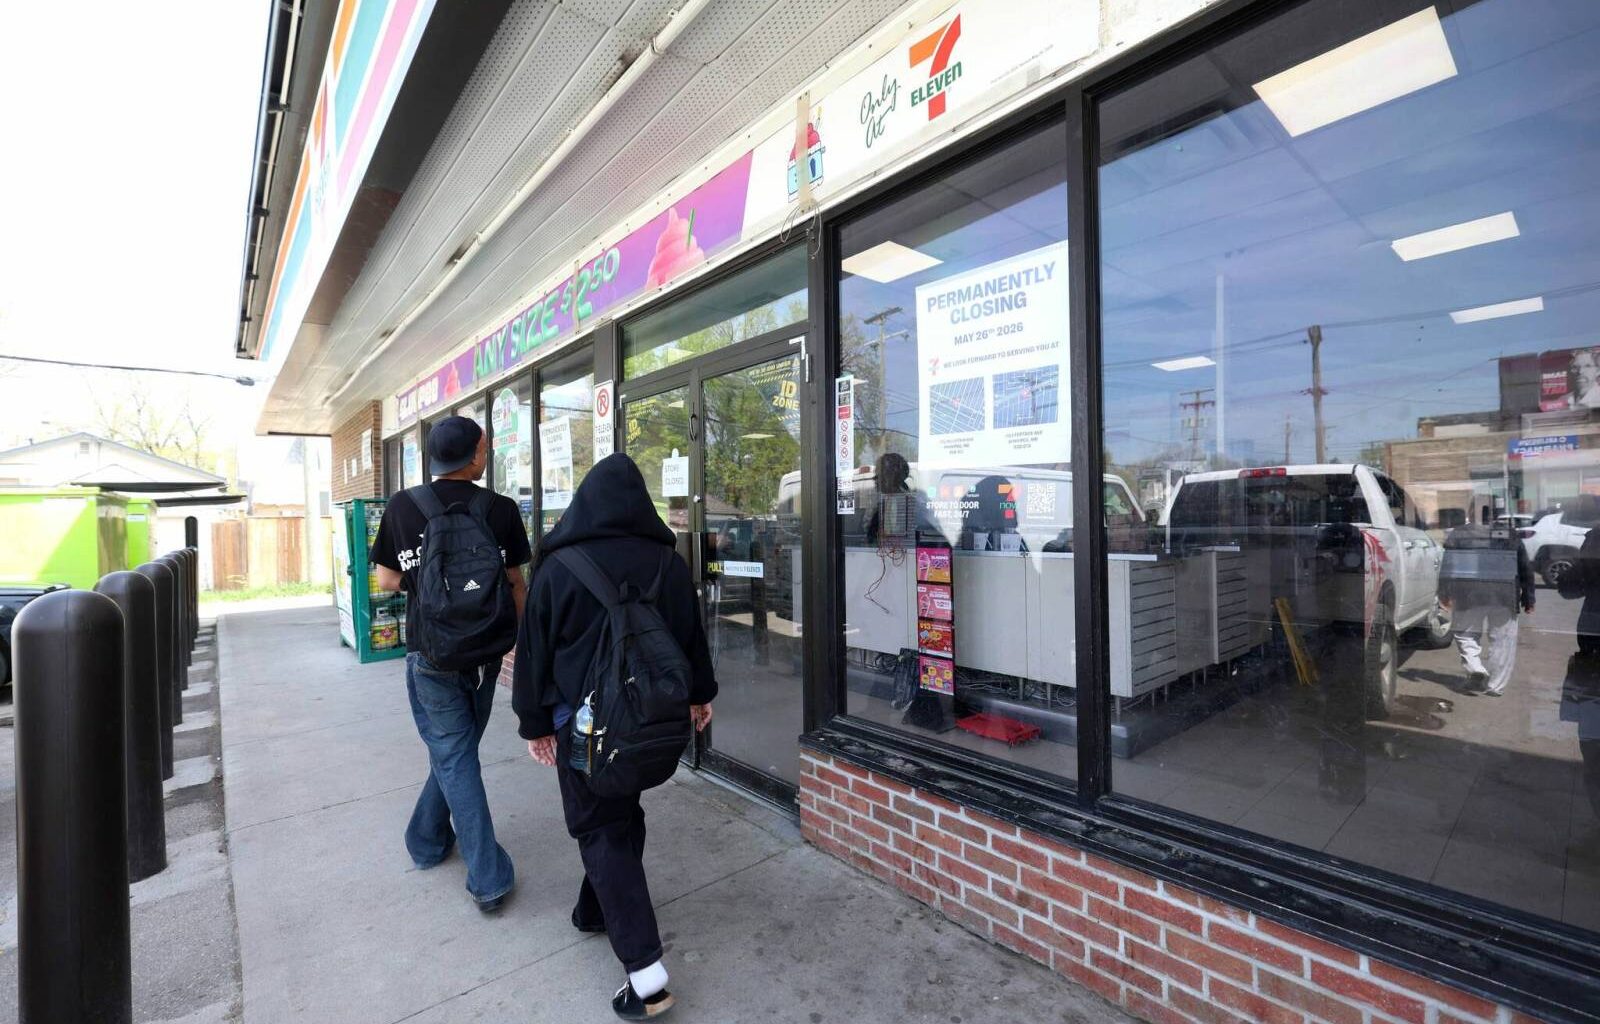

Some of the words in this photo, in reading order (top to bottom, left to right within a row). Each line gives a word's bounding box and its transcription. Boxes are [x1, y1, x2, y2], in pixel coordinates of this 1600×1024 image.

[860, 74, 902, 125] Only
[927, 261, 1056, 313] PERMANENTLY
[951, 291, 1027, 325] CLOSING
[476, 322, 508, 377] ANY
[511, 289, 559, 360] SIZE
[954, 332, 975, 346] MAY
[997, 322, 1024, 336] 2026
[967, 353, 997, 364] FORWARD
[998, 351, 1006, 359] TO
[1006, 346, 1035, 357] SERVING
[1036, 343, 1050, 352] YOU
[1050, 341, 1060, 349] AT
[781, 380, 797, 398] ID
[772, 395, 800, 410] ZONE
[960, 501, 979, 509] DOOR
